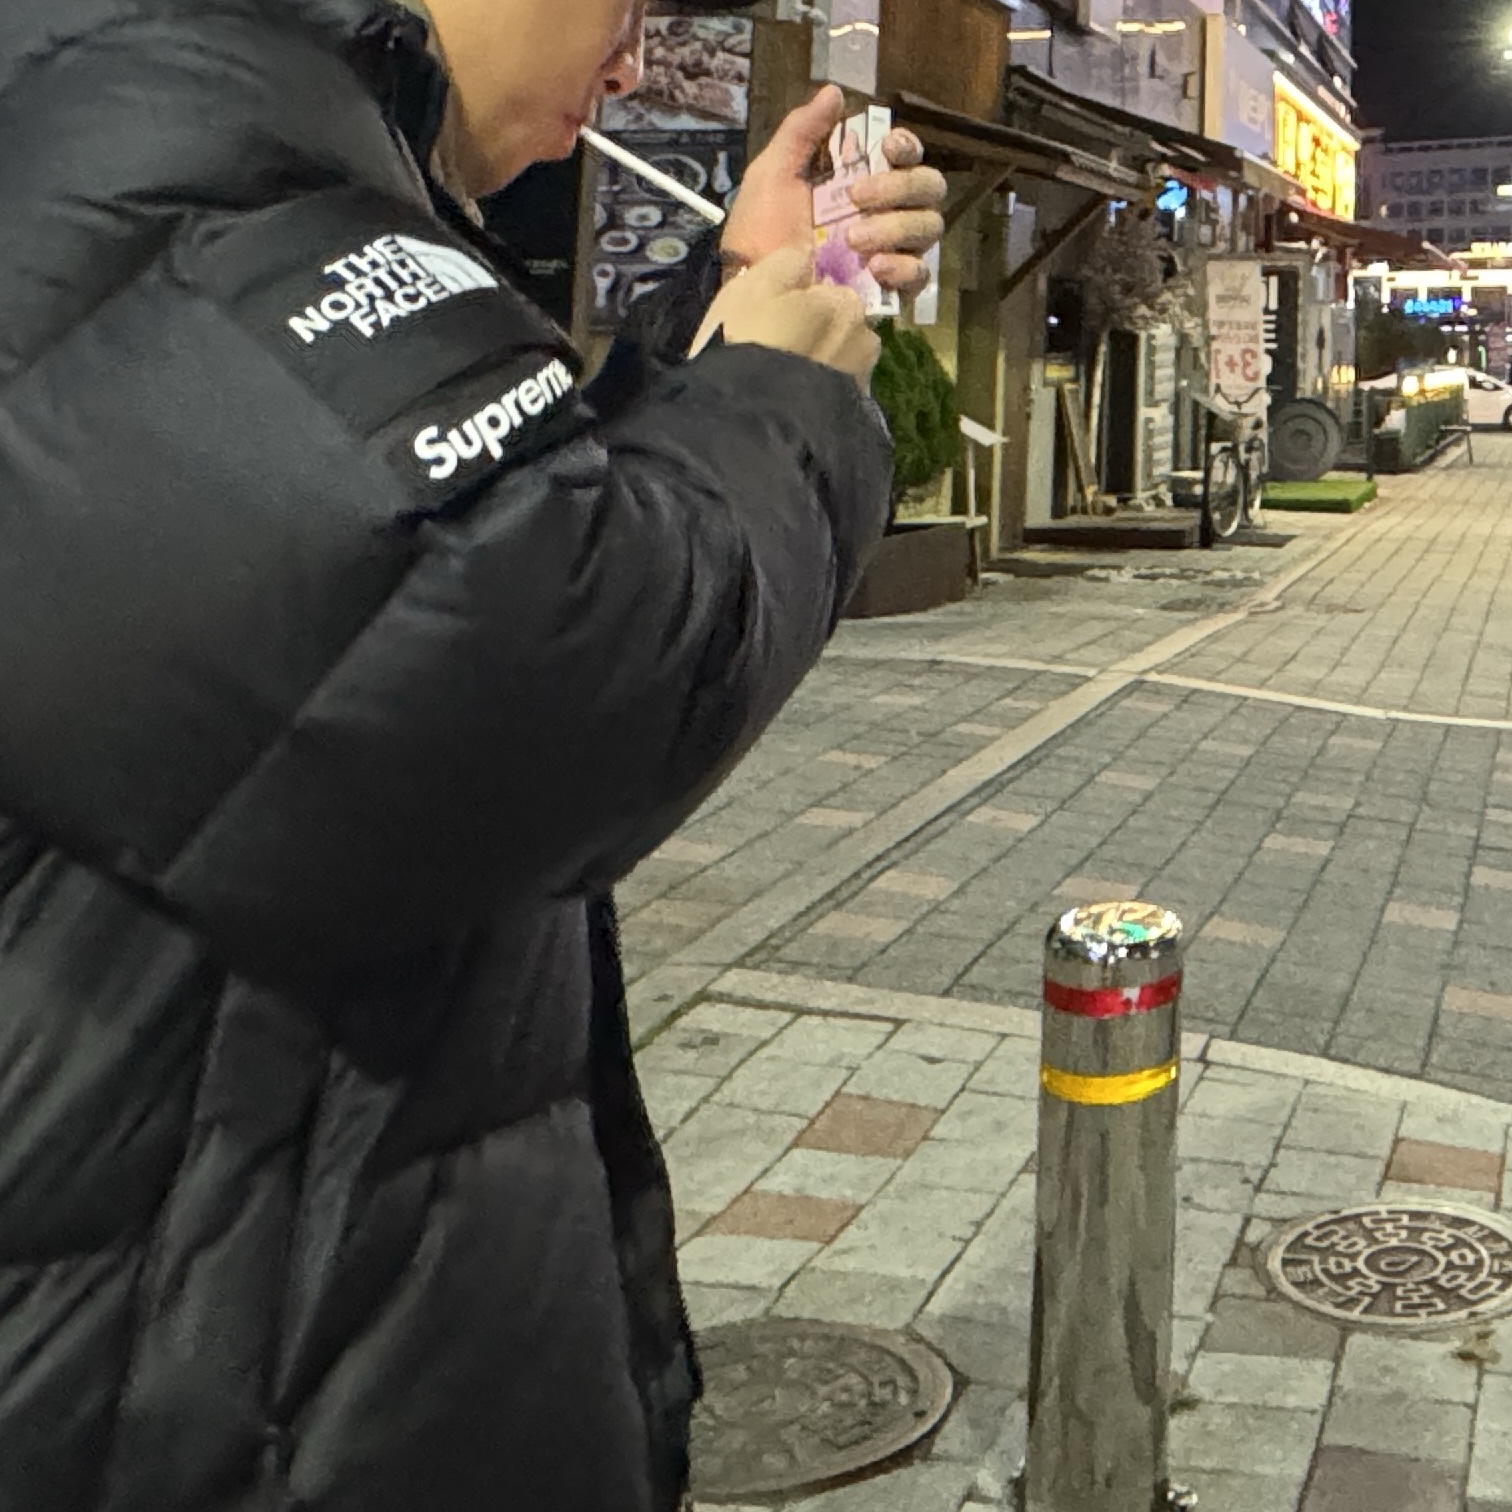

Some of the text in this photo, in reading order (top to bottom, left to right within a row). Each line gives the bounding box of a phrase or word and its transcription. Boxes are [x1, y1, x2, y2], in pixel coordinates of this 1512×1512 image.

[323, 234, 403, 285] THE
[288, 256, 433, 344] NORTH
[350, 281, 449, 338] FACE
